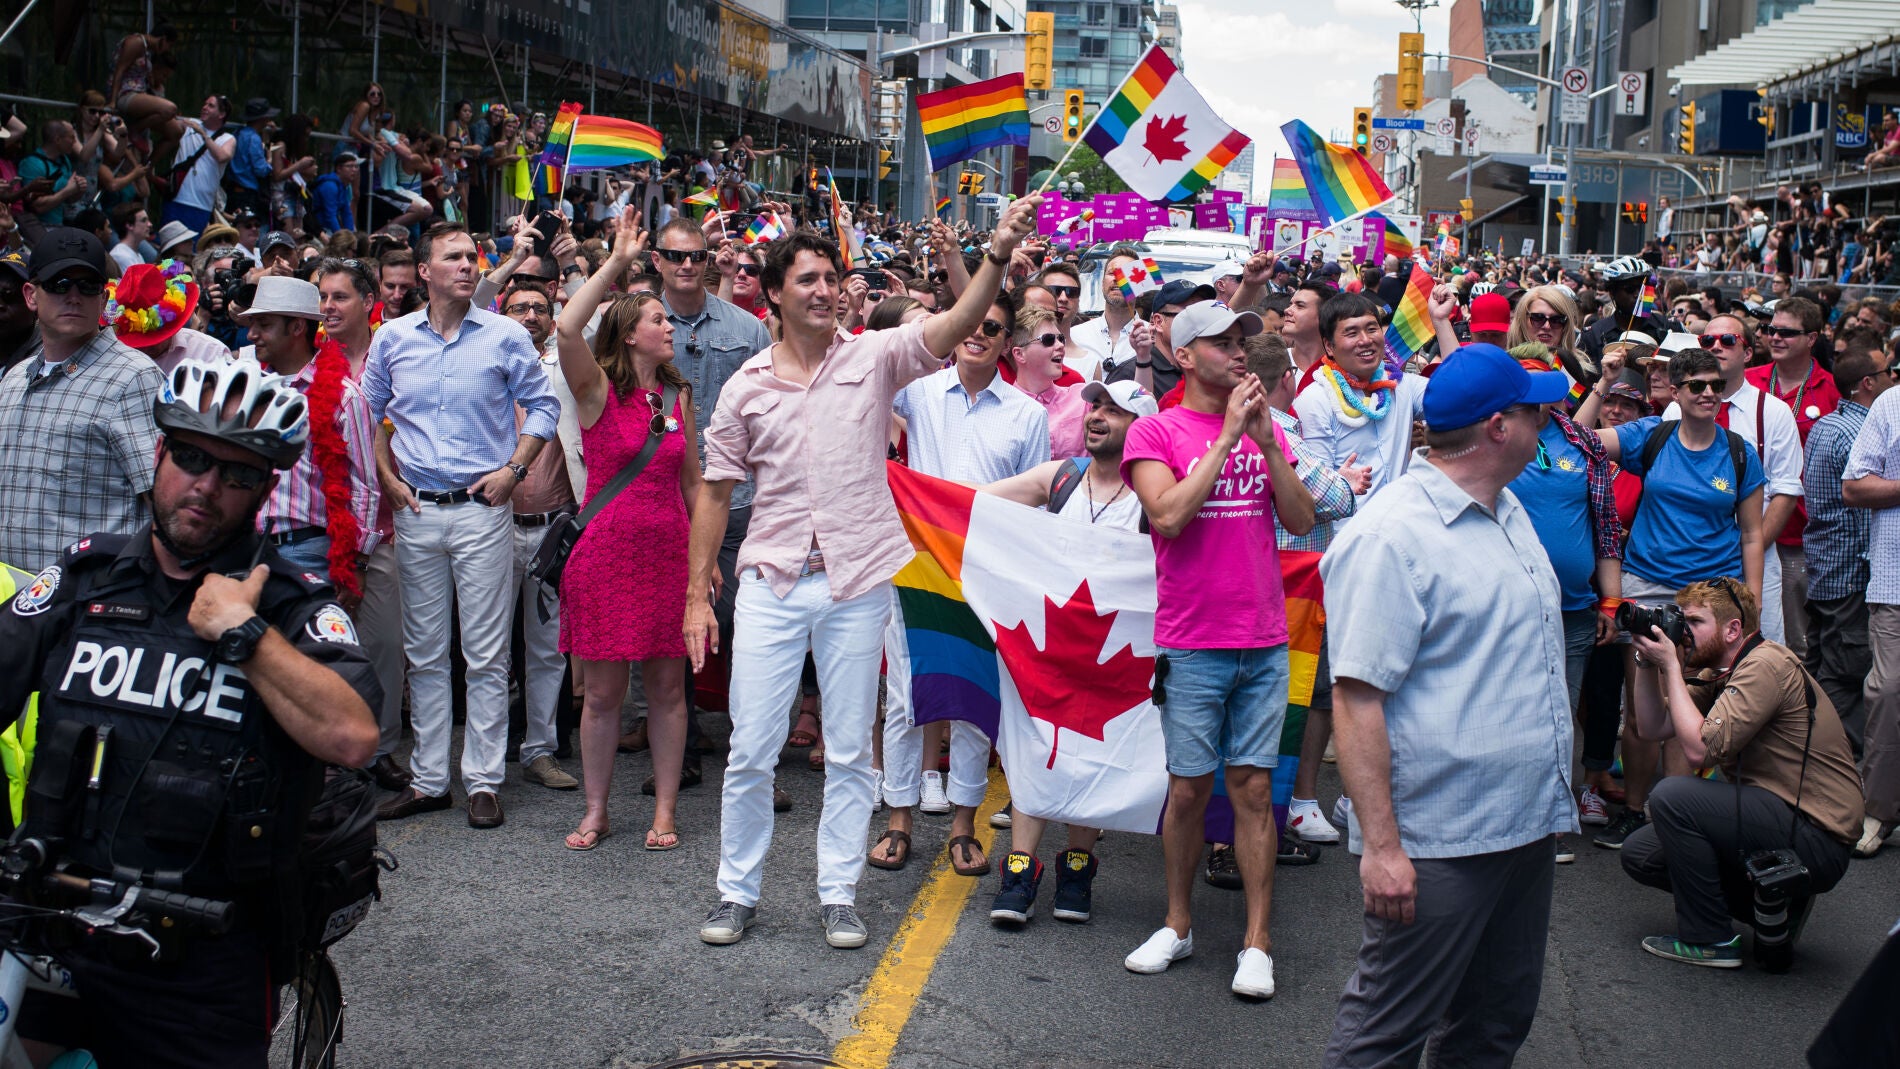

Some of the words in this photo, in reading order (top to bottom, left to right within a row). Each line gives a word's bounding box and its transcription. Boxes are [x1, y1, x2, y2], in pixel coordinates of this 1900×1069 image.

[517, 8, 590, 46] RESIDENTIAL
[1385, 119, 1406, 128] Bloor
[1836, 132, 1863, 143] RBC
[1233, 453, 1265, 474] SIT
[1214, 478, 1235, 498] TH
[1238, 473, 1268, 496] US
[1220, 509, 1252, 518] TORONTO
[60, 641, 249, 723] POLICE
[1008, 854, 1030, 870] EWING
[1067, 852, 1089, 866] EWING
